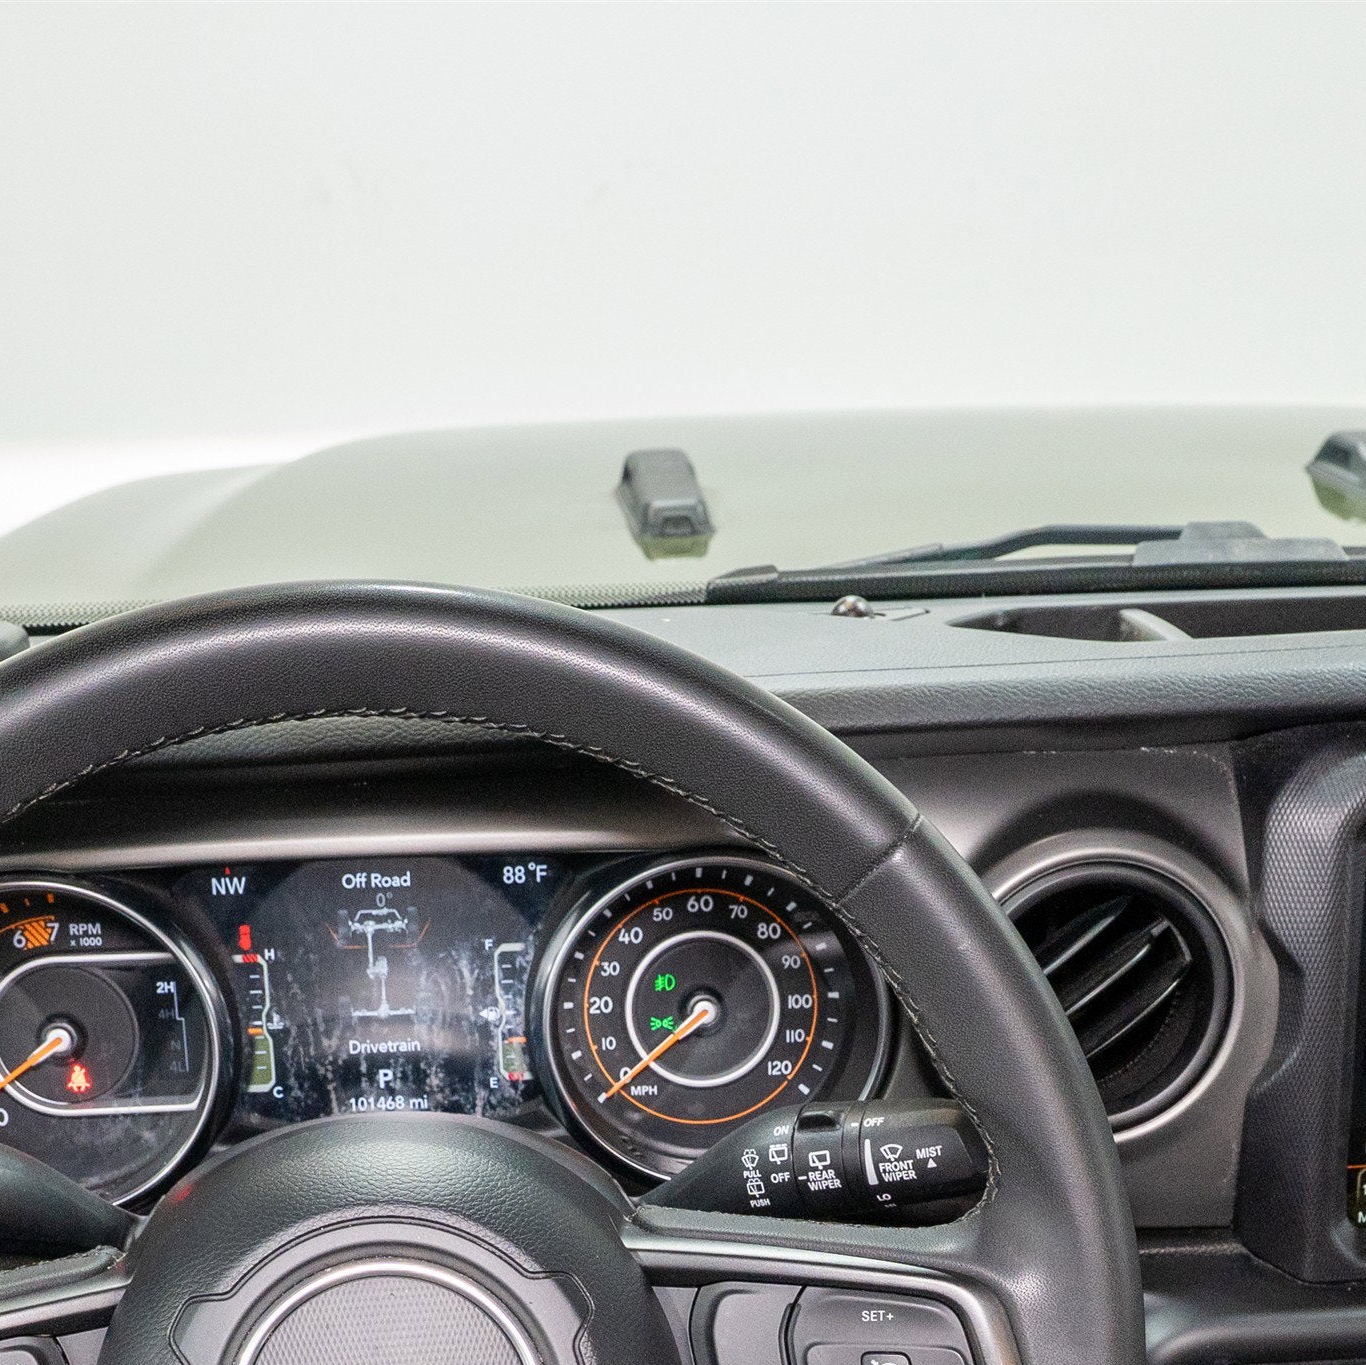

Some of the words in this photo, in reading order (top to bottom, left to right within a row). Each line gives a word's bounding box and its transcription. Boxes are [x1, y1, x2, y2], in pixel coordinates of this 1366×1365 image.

[212, 877, 246, 895] NW
[342, 874, 366, 888] Off
[370, 872, 411, 887] Road
[687, 895, 713, 912] 60
[653, 907, 673, 922] 50
[729, 905, 748, 919] 70
[46, 922, 59, 941] 7
[69, 924, 101, 936] RPM
[619, 927, 643, 944] 40
[757, 923, 781, 939] 80
[13, 933, 26, 949] 6
[79, 937, 102, 947] 1000
[485, 939, 493, 950] F
[265, 949, 275, 960] H
[781, 955, 801, 969] 90
[601, 961, 620, 976] 30
[156, 982, 174, 993] 2H
[589, 997, 613, 1014] 20
[788, 995, 813, 1009] 100
[786, 1029, 806, 1043] 110
[349, 1039, 420, 1054] Drivetrain
[601, 1037, 616, 1050] 10
[767, 1060, 792, 1075] 120
[379, 1070, 393, 1088] P
[490, 1078, 498, 1089] E
[273, 1086, 283, 1098] C
[631, 1085, 658, 1096] MPH
[410, 1097, 427, 1109] mi
[864, 1118, 885, 1128] OFF
[774, 1126, 789, 1137] ON
[915, 1146, 943, 1160] MIST
[879, 1161, 914, 1173] FRONT
[743, 1170, 762, 1178] PULL
[771, 1173, 790, 1183] OFF
[809, 1170, 835, 1181] REAR
[882, 1170, 917, 1182] WIPER
[808, 1179, 842, 1191] WIPER
[750, 1198, 770, 1207] PUSH
[877, 1194, 891, 1202] LO
[861, 1310, 894, 1322] SET+
